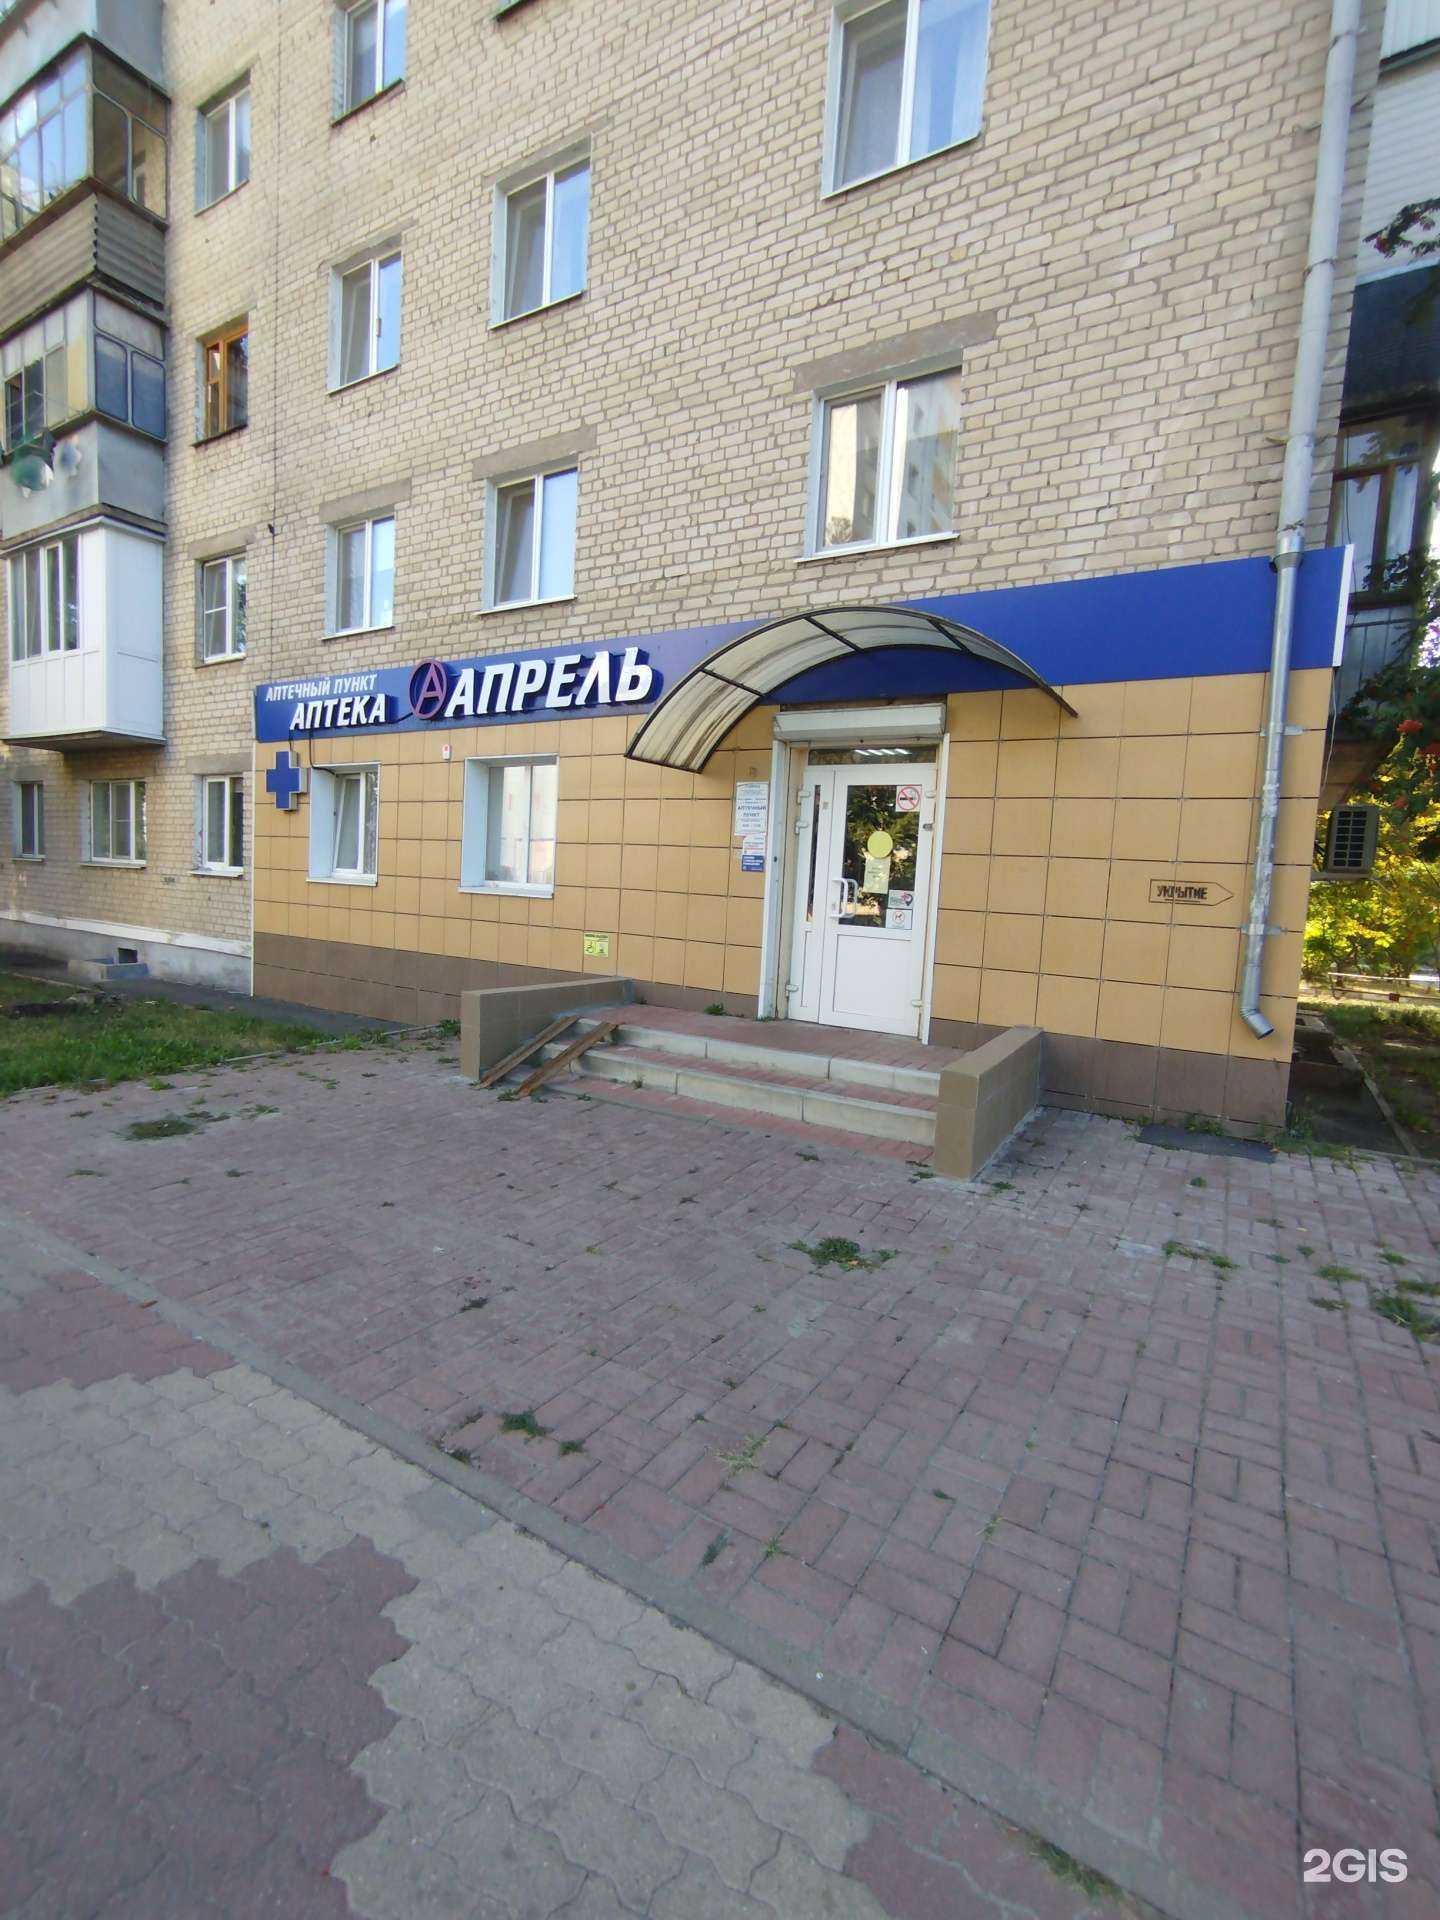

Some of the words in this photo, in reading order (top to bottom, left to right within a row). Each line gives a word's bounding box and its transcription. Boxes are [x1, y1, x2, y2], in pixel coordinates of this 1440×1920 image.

[266, 677, 331, 701] АПТЕЧНЫЙ
[333, 673, 378, 695] ПУНКТ
[444, 647, 653, 717] АПРЕЛЬ
[290, 693, 386, 730] АПТЕКА
[1157, 886, 1208, 900] УКРЫТИЕ
